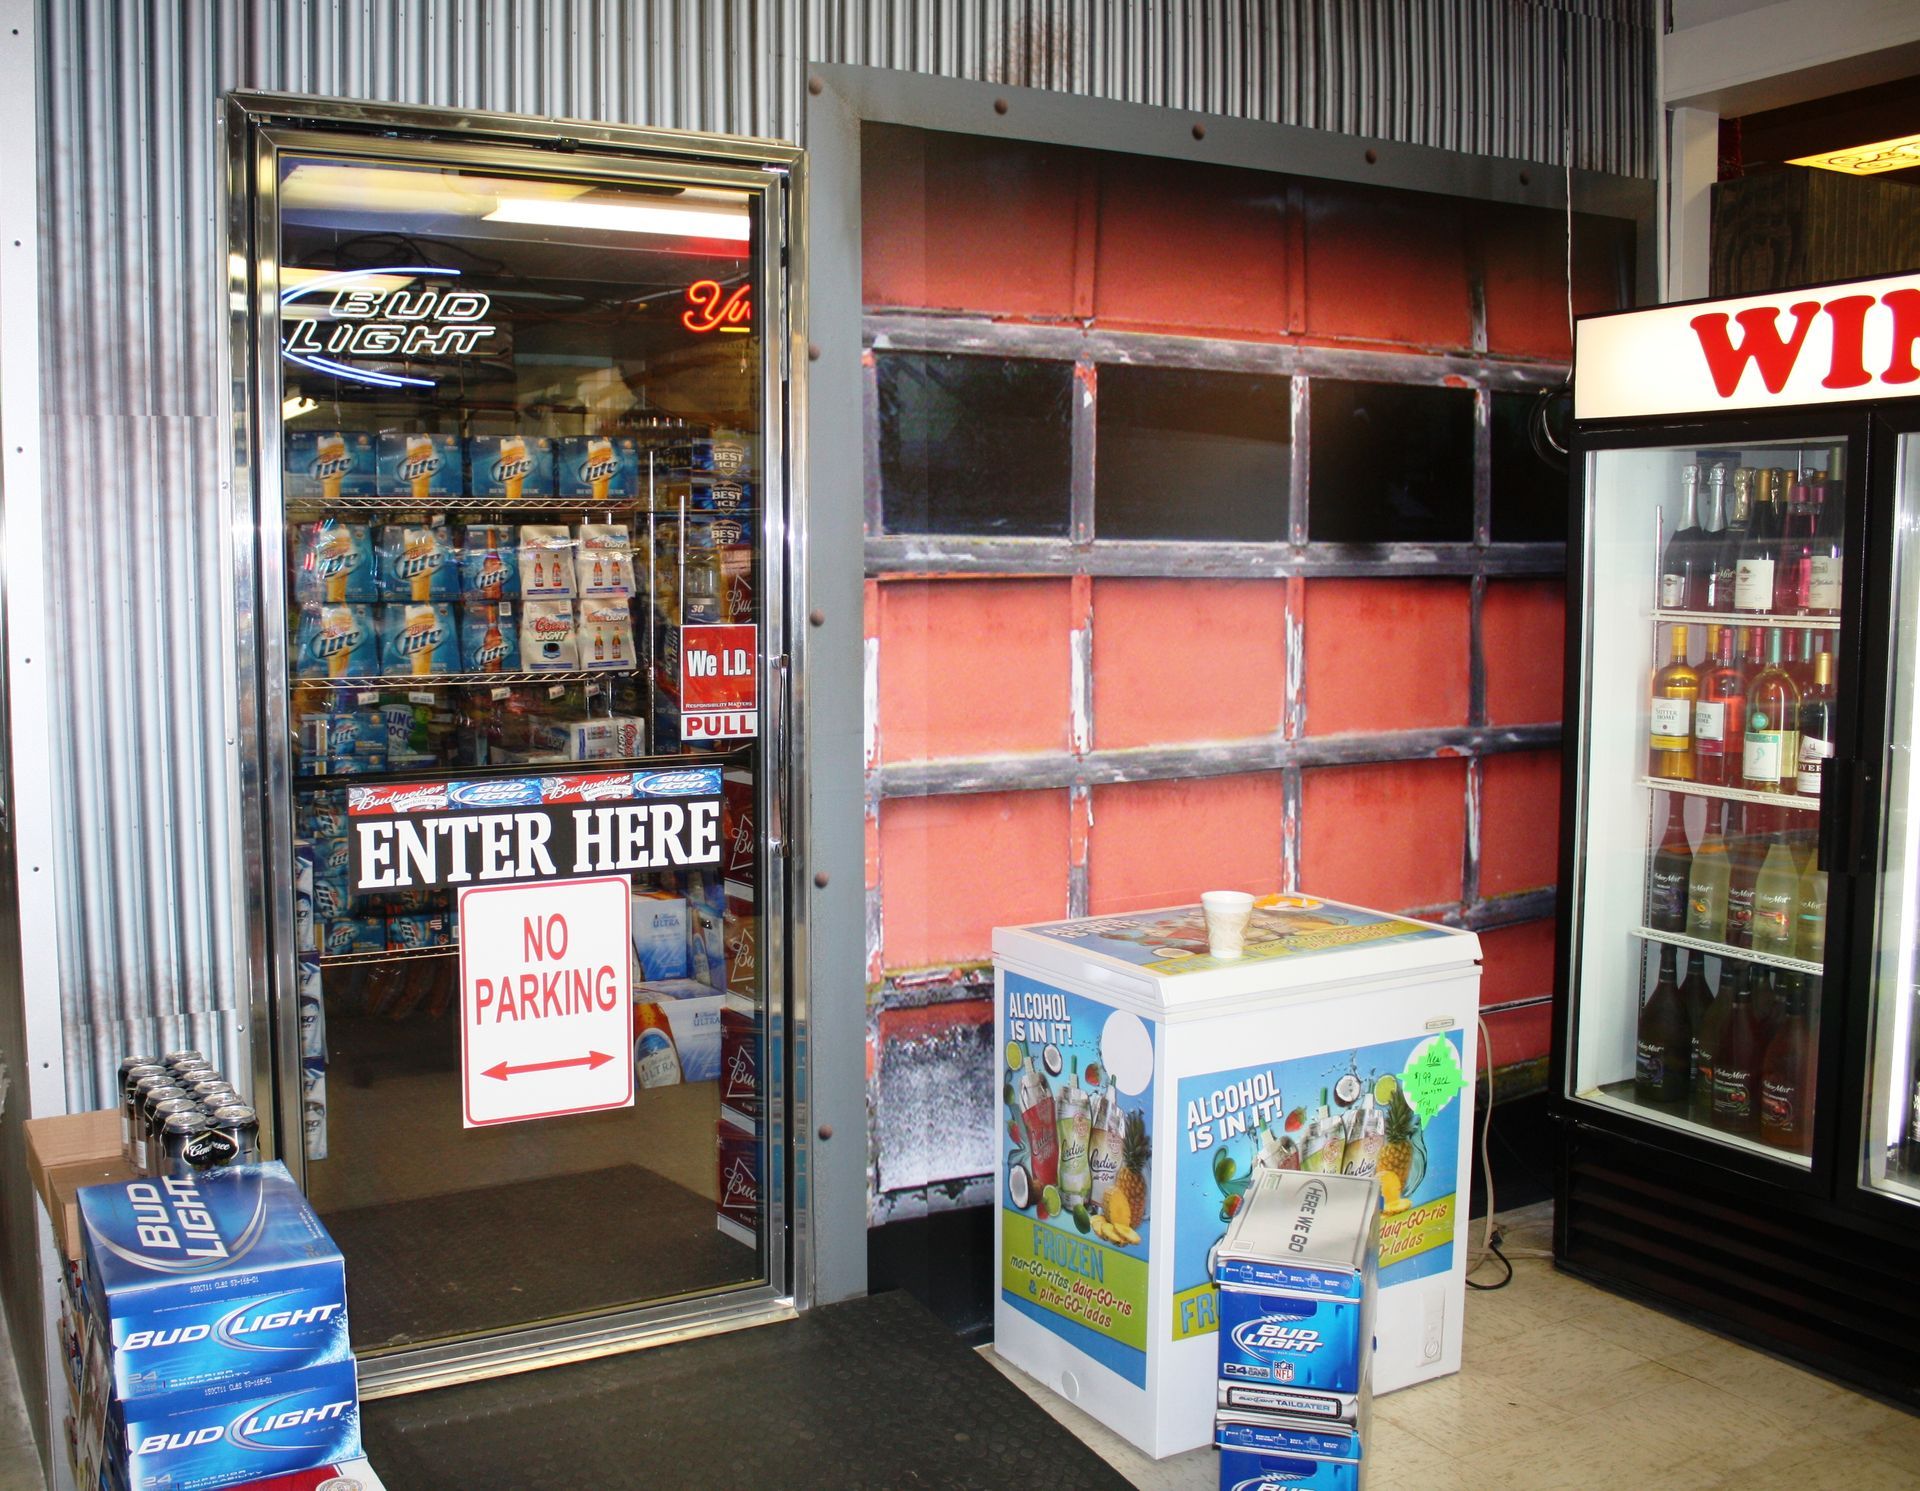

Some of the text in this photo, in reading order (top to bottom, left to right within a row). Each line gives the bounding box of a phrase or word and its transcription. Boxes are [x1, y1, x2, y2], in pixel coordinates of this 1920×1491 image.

[328, 286, 491, 322] BUD
[681, 279, 751, 332] Yu
[284, 318, 497, 355] LIGHT
[714, 452, 743, 461] BEST
[712, 491, 741, 500] BEST
[711, 530, 740, 539] BEST
[535, 616, 570, 632] Coors
[535, 631, 568, 642] LIGHT
[402, 629, 442, 656] Lite
[687, 649, 751, 677] We I.D.
[686, 715, 754, 737] PULL
[476, 782, 527, 793] BUD
[549, 775, 630, 800] Budweiser
[648, 780, 712, 791] LIGHT
[656, 774, 705, 783] BUD
[357, 785, 444, 811] Budweiser
[462, 790, 533, 801] LIGHT
[356, 800, 720, 888] ENTER HERE
[652, 918, 680, 928] ULTRA
[523, 913, 568, 963] NO
[475, 965, 616, 1025] PARKING
[1009, 992, 1072, 1022] ALCOHOL
[693, 1015, 720, 1027] ULTRA
[1010, 1019, 1073, 1047] IS IN IT!
[1187, 1070, 1280, 1130] ALCOHOL
[1189, 1096, 1284, 1153] IS IN IT!
[126, 1183, 181, 1249] BUD
[161, 1176, 229, 1258] LIGHT
[1288, 1187, 1323, 1253] HERE WE GO
[1032, 1223, 1105, 1284] FROZEN
[1028, 1279, 1038, 1295] &
[121, 1303, 341, 1351] BUD LIGHT
[1257, 1324, 1319, 1341] BUD
[1243, 1333, 1324, 1353] LIGHT
[128, 1371, 157, 1385] 24
[1225, 1364, 1248, 1376] 24
[1275, 1368, 1293, 1380] NFL
[137, 1400, 353, 1455] BUD LIGHT
[142, 1472, 172, 1487] 24
